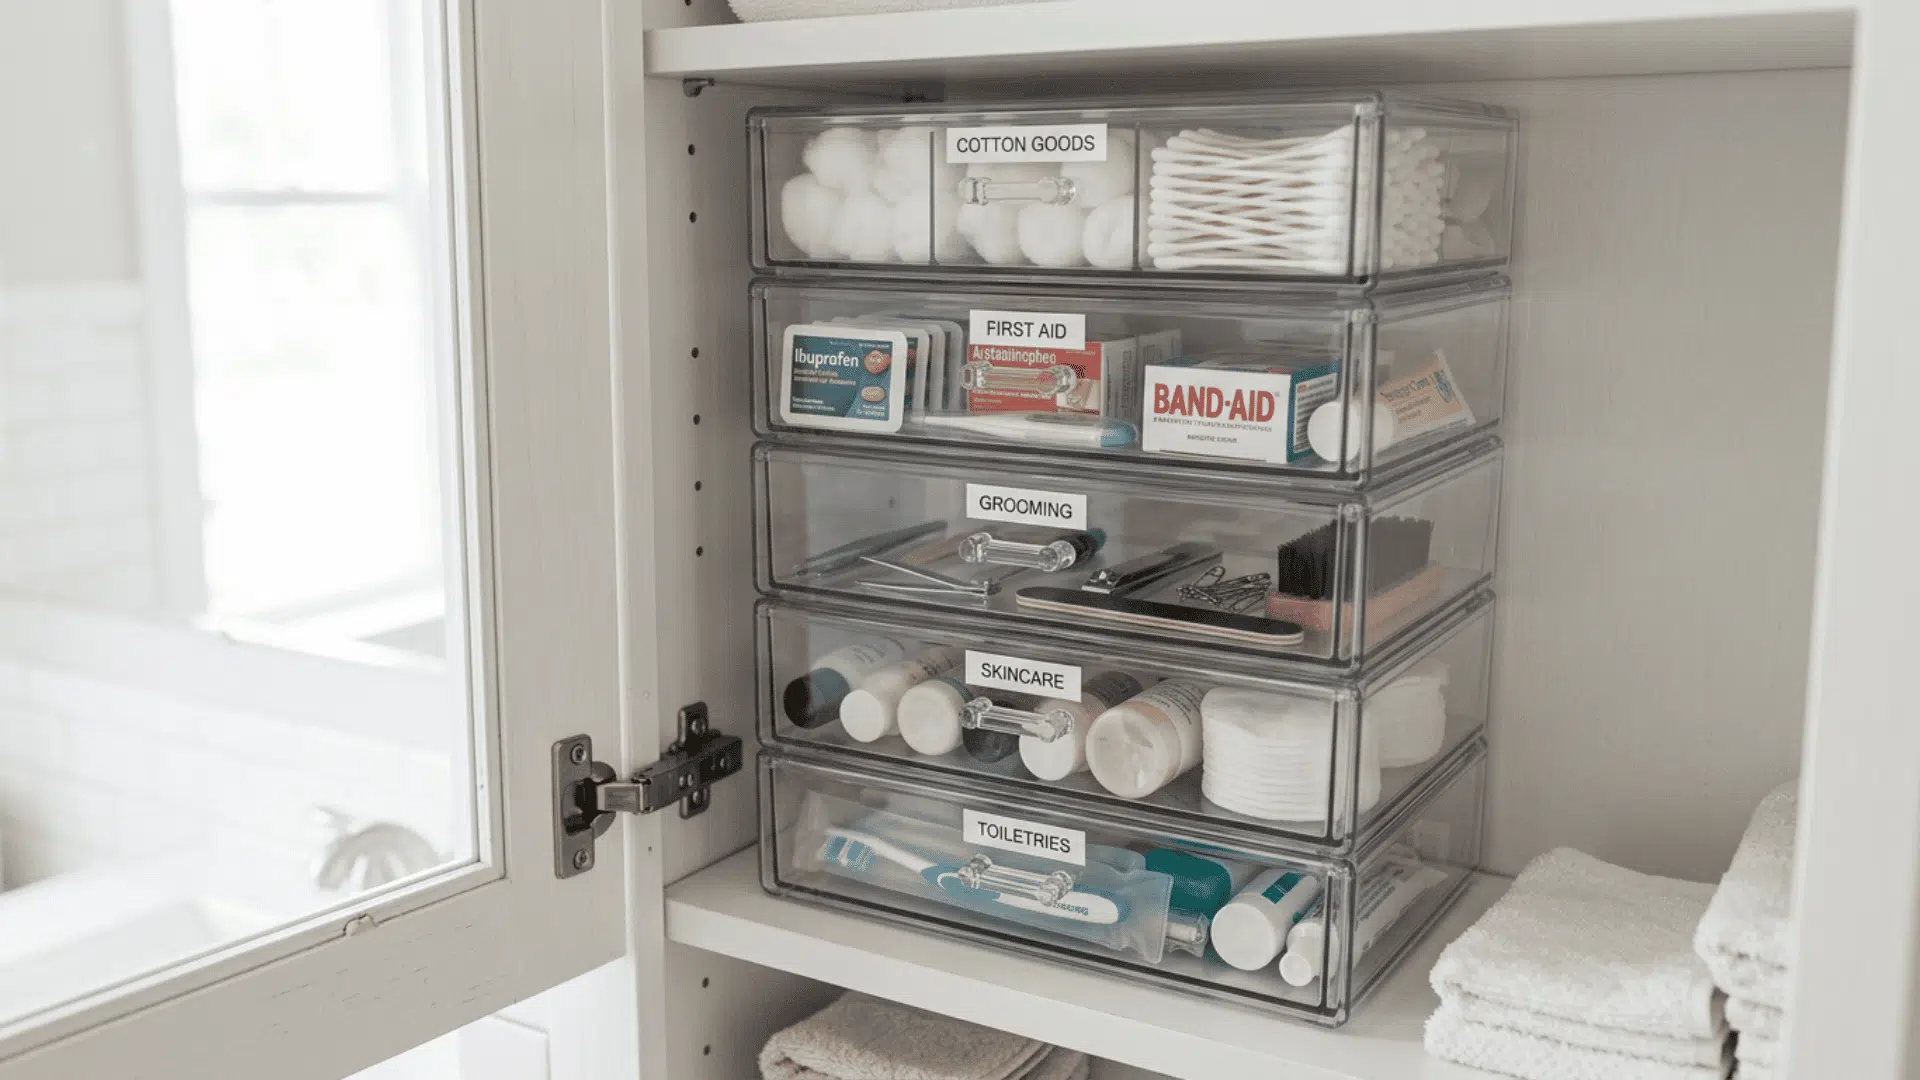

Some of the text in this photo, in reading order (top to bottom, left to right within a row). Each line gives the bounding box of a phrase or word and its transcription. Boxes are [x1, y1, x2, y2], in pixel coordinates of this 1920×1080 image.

[956, 135, 1096, 153] COTTON GOODS
[986, 320, 1067, 339] FIRST AID
[1153, 382, 1275, 423] BAND-AID
[979, 495, 1073, 519] GROOMING
[981, 663, 1065, 690] SKINCARE
[977, 821, 1071, 853] TOILETRIES
